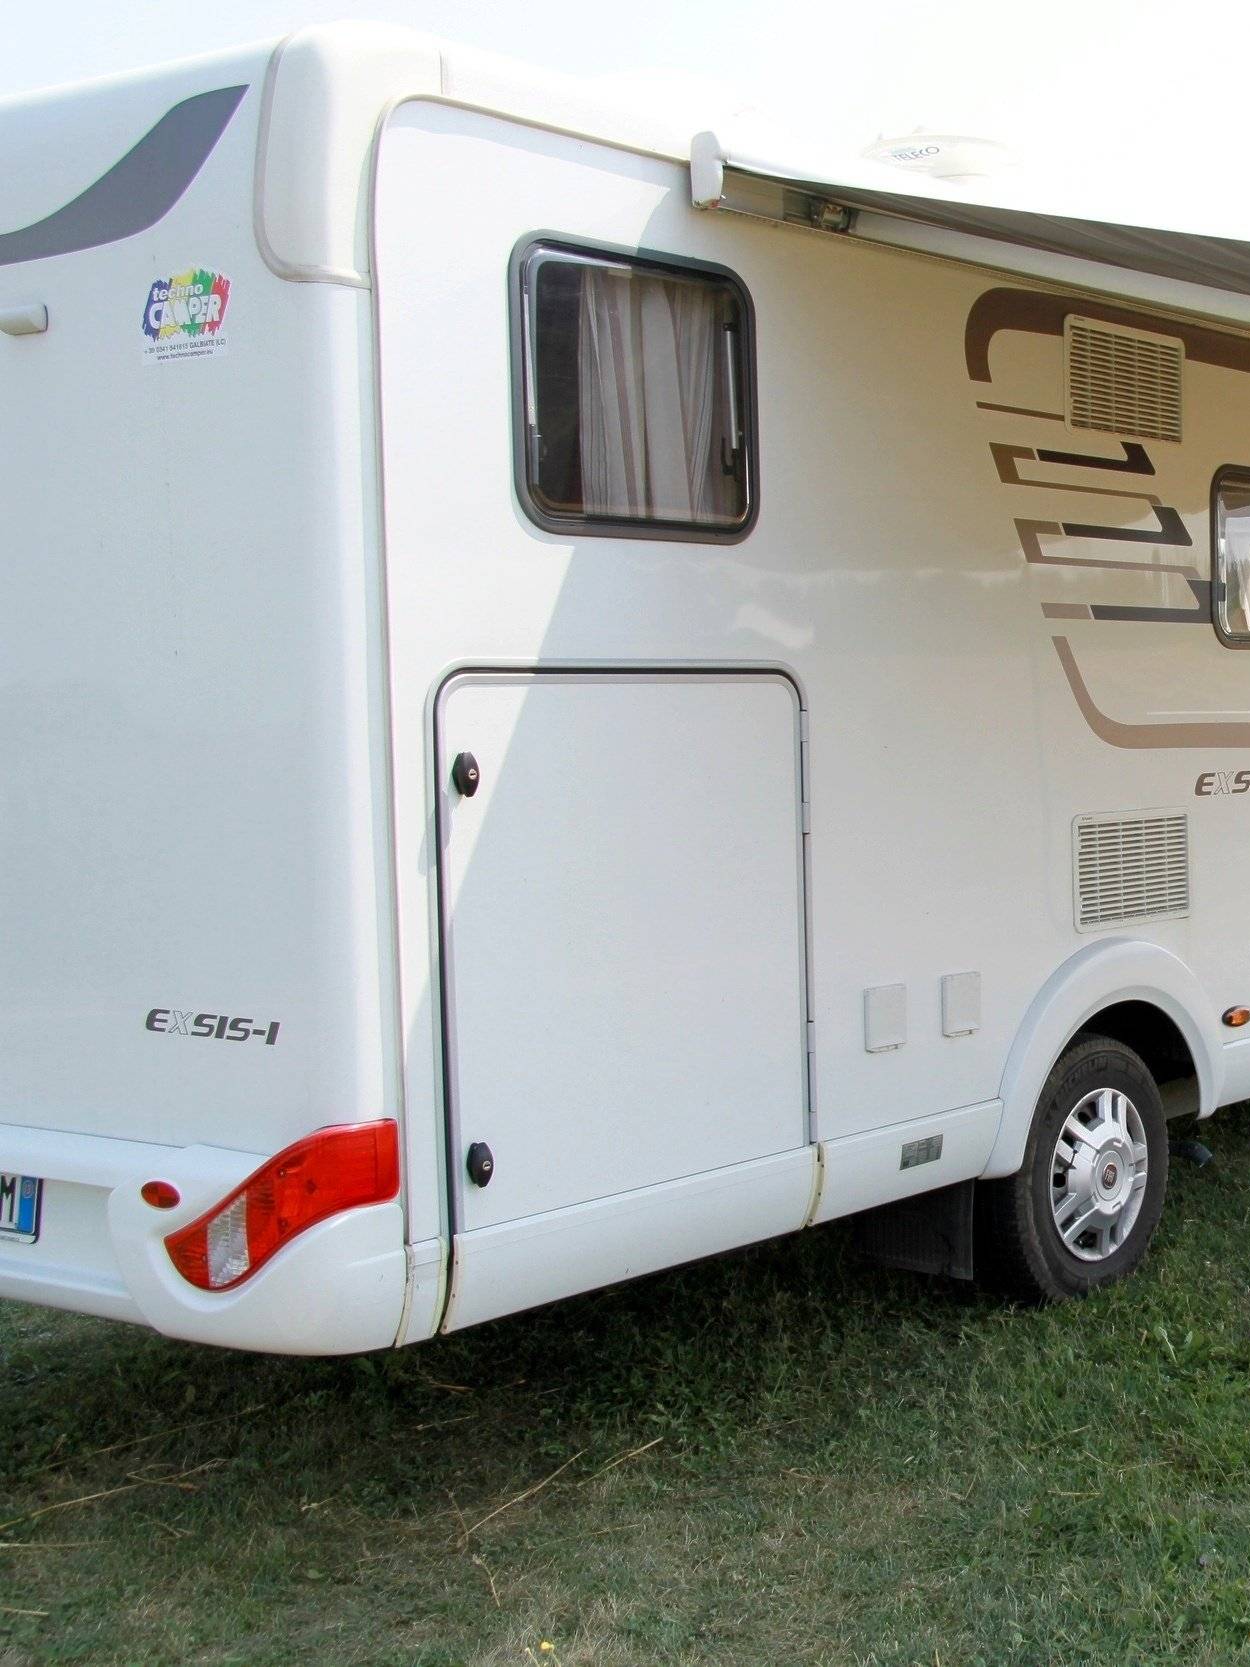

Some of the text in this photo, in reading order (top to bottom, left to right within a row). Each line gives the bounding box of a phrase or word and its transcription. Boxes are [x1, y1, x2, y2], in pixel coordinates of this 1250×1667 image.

[893, 146, 940, 161] TELECO
[153, 284, 204, 301] techno
[149, 294, 222, 329] CAMPER
[145, 1008, 281, 1046] EXSIS-I
